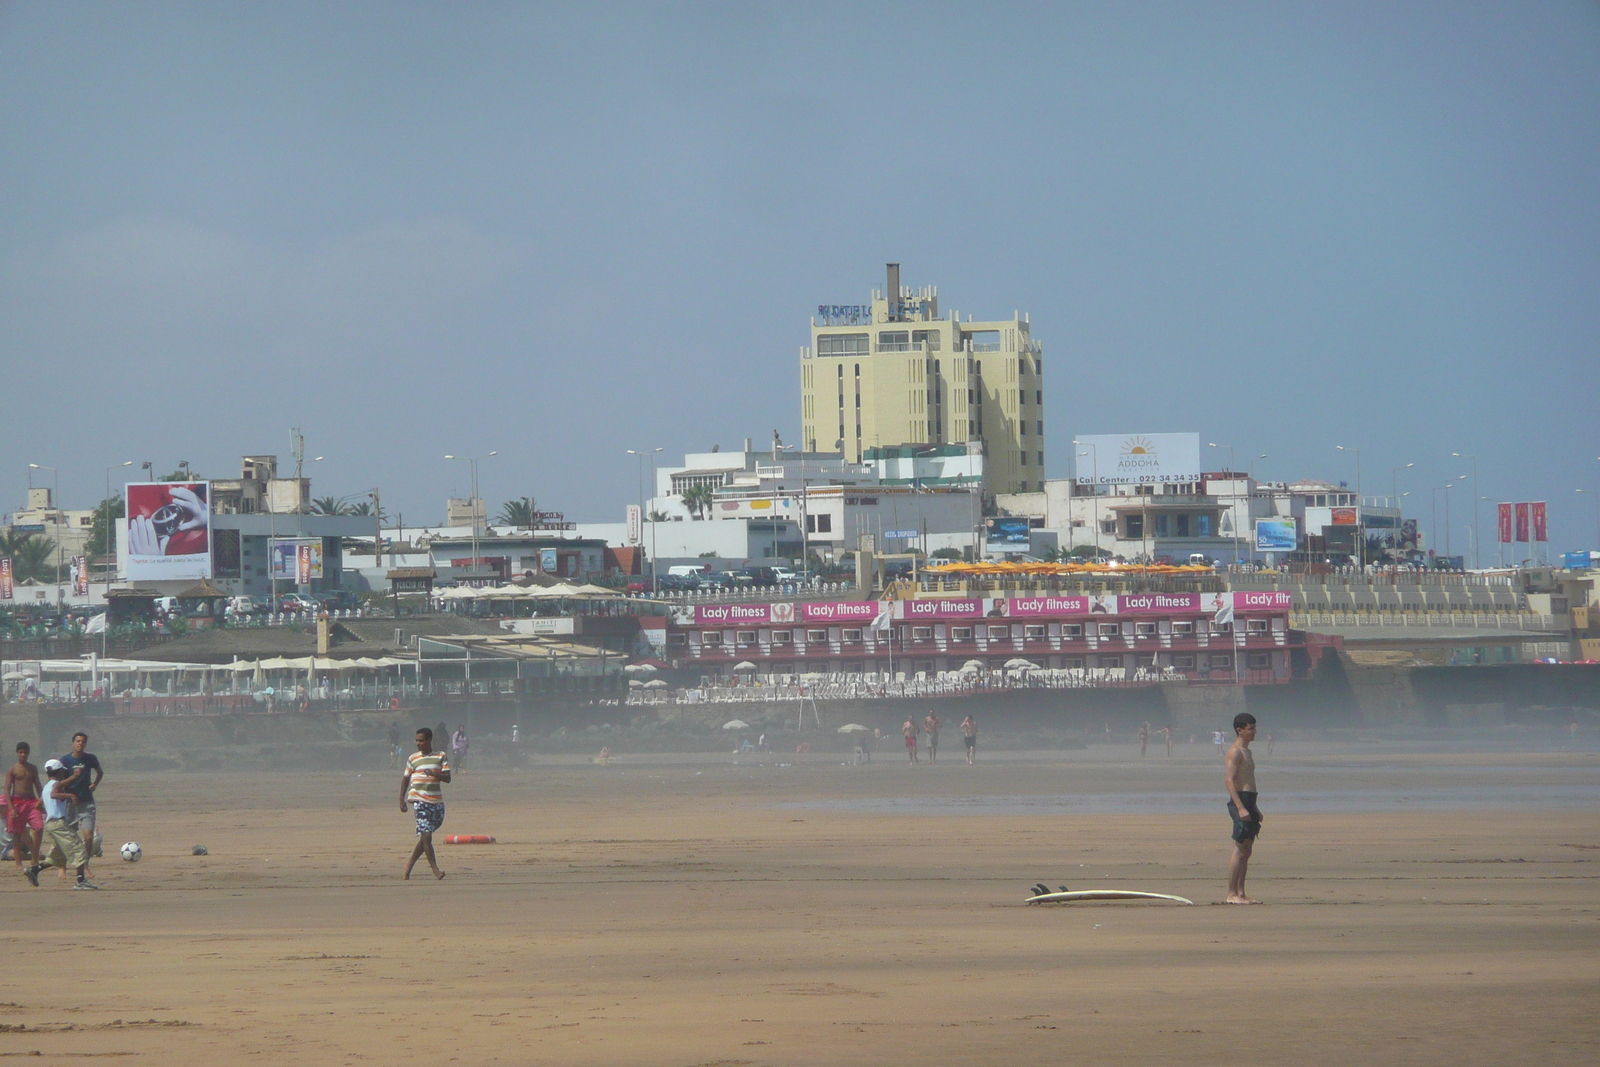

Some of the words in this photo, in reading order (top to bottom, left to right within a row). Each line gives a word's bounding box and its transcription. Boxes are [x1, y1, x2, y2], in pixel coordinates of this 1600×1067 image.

[1117, 460, 1160, 468] ADDOHA
[1100, 476, 1130, 484] Center
[1140, 475, 1156, 483] 022
[1174, 474, 1185, 482] 34
[1258, 536, 1267, 544] 50
[456, 580, 496, 588] TAHITI
[1017, 599, 1044, 612] Lady
[1046, 598, 1081, 610] fitness
[1125, 596, 1152, 609] Lady
[1155, 595, 1190, 607] fitness
[1245, 593, 1272, 606] Lady
[702, 606, 729, 620] Lady
[731, 605, 765, 618] fitness
[808, 604, 834, 617] Lady
[837, 602, 871, 615] fitness
[911, 601, 938, 614] Lady
[941, 600, 975, 612] fitness
[531, 620, 556, 628] TAHITI
